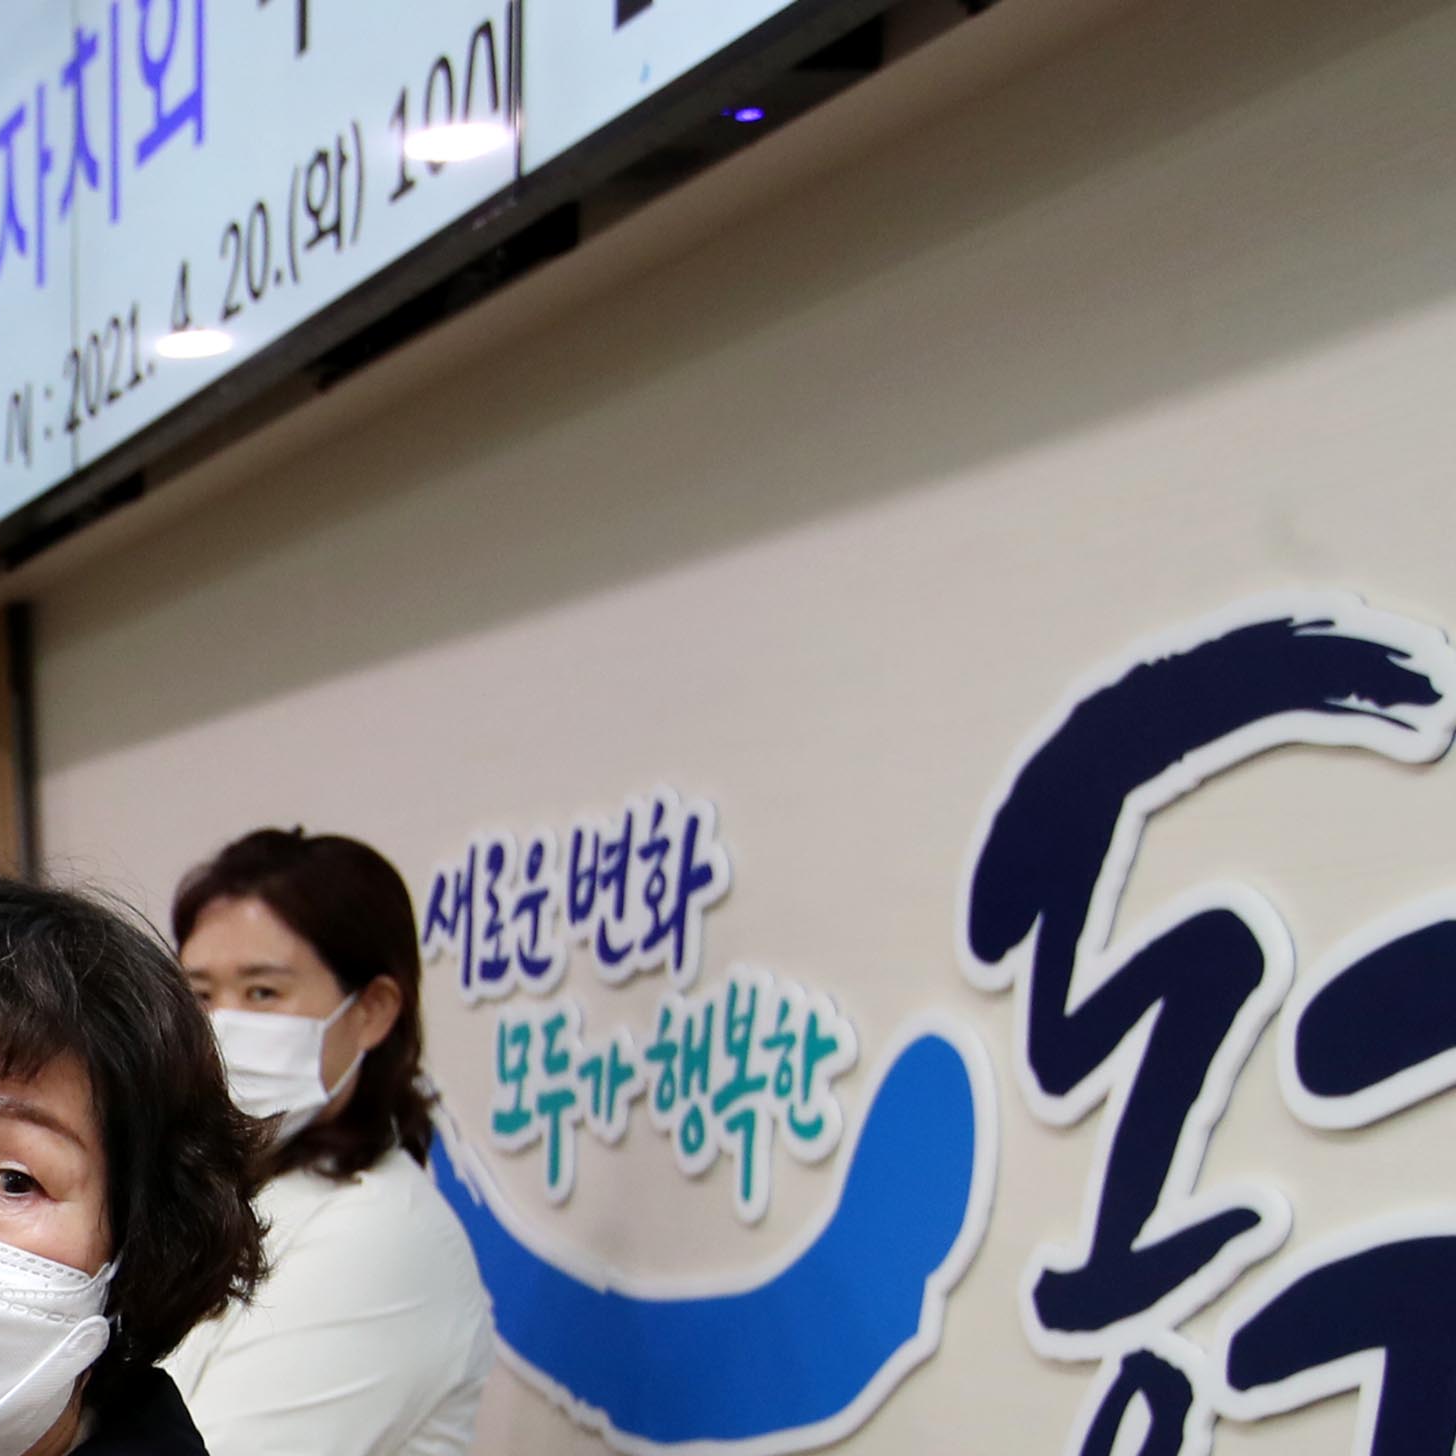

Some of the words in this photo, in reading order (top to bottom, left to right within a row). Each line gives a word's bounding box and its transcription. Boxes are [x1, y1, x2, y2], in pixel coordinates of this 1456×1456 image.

[63, 301, 155, 433] 2021.
[423, 839, 553, 988] 새로운
[568, 801, 713, 971] 변화
[494, 1012, 635, 1188] 모두가
[646, 981, 838, 1202] 행복한
